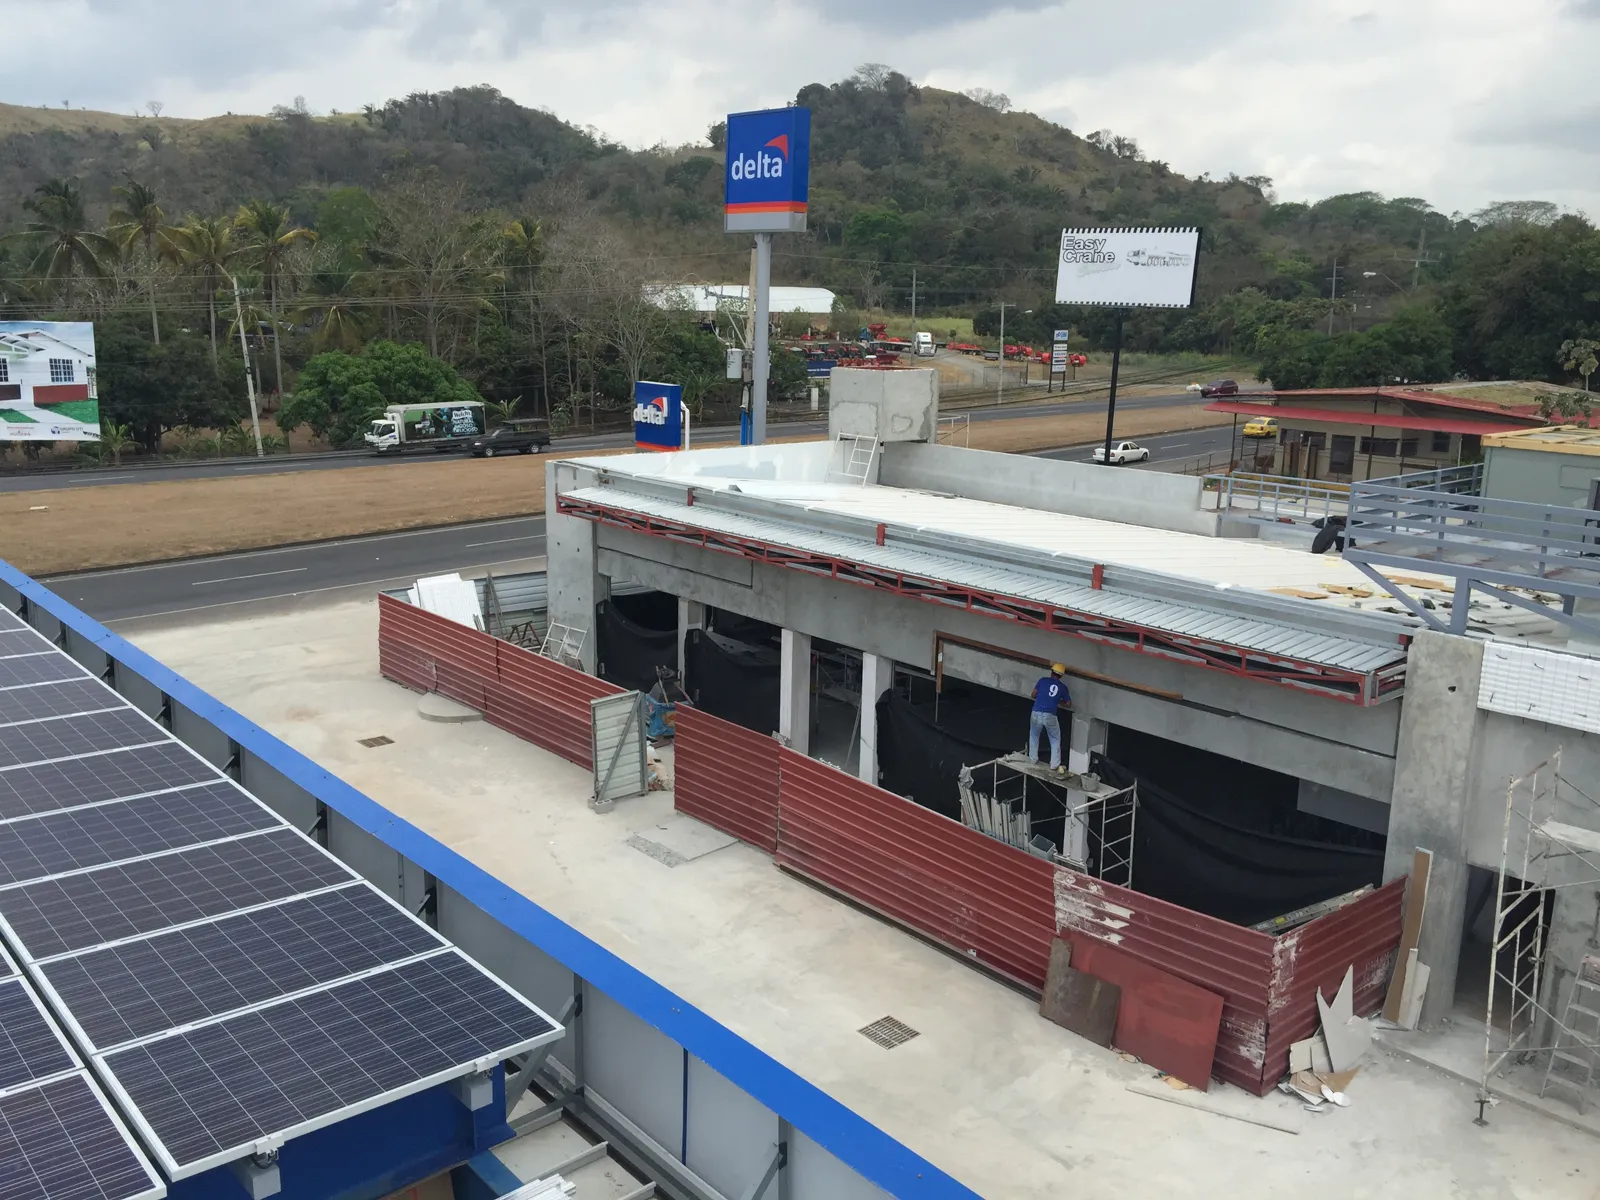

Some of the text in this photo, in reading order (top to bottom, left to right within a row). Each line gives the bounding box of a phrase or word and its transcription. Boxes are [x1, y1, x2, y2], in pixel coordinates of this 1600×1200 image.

[731, 151, 783, 180] delta
[1062, 235, 1107, 253] Easy
[1062, 249, 1116, 263] Crane
[633, 403, 665, 425] delta
[1048, 684, 1059, 698] 9
